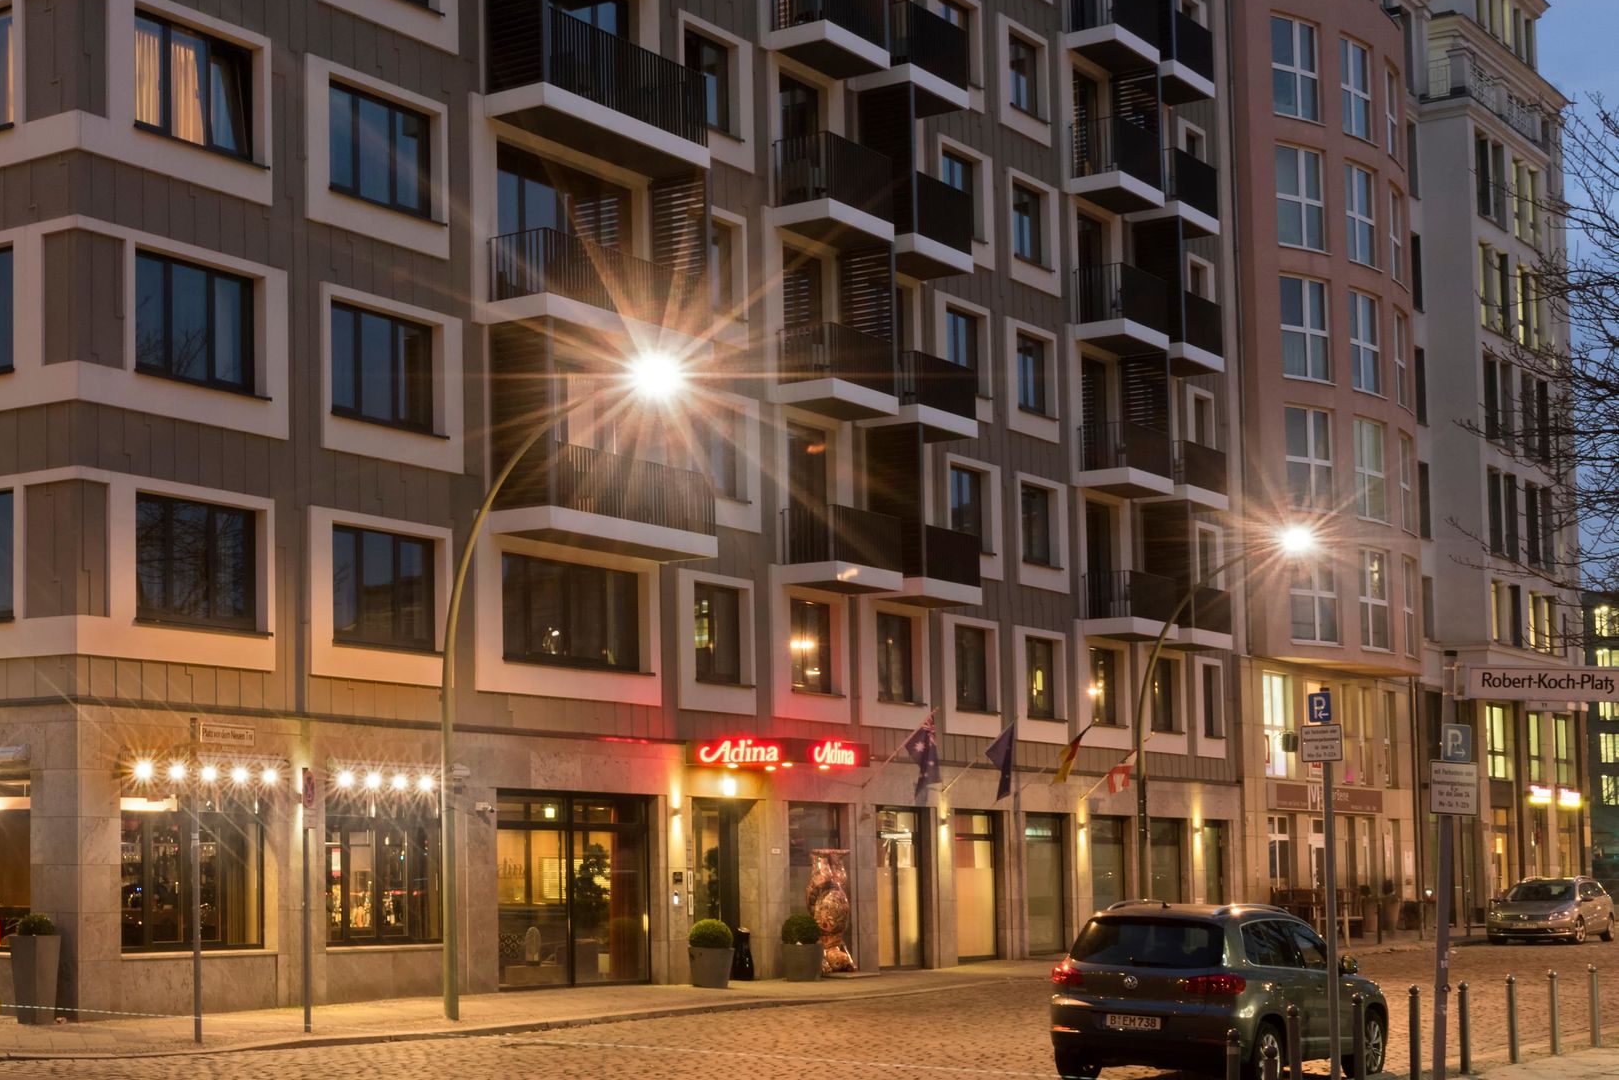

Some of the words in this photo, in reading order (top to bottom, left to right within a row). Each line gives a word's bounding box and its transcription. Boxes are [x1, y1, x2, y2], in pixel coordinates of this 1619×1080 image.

[1481, 671, 1615, 694] Robert-Koch-Platz
[1313, 696, 1326, 719] P
[699, 739, 779, 763] Adina
[814, 741, 855, 765] Adina
[1447, 728, 1462, 757] P
